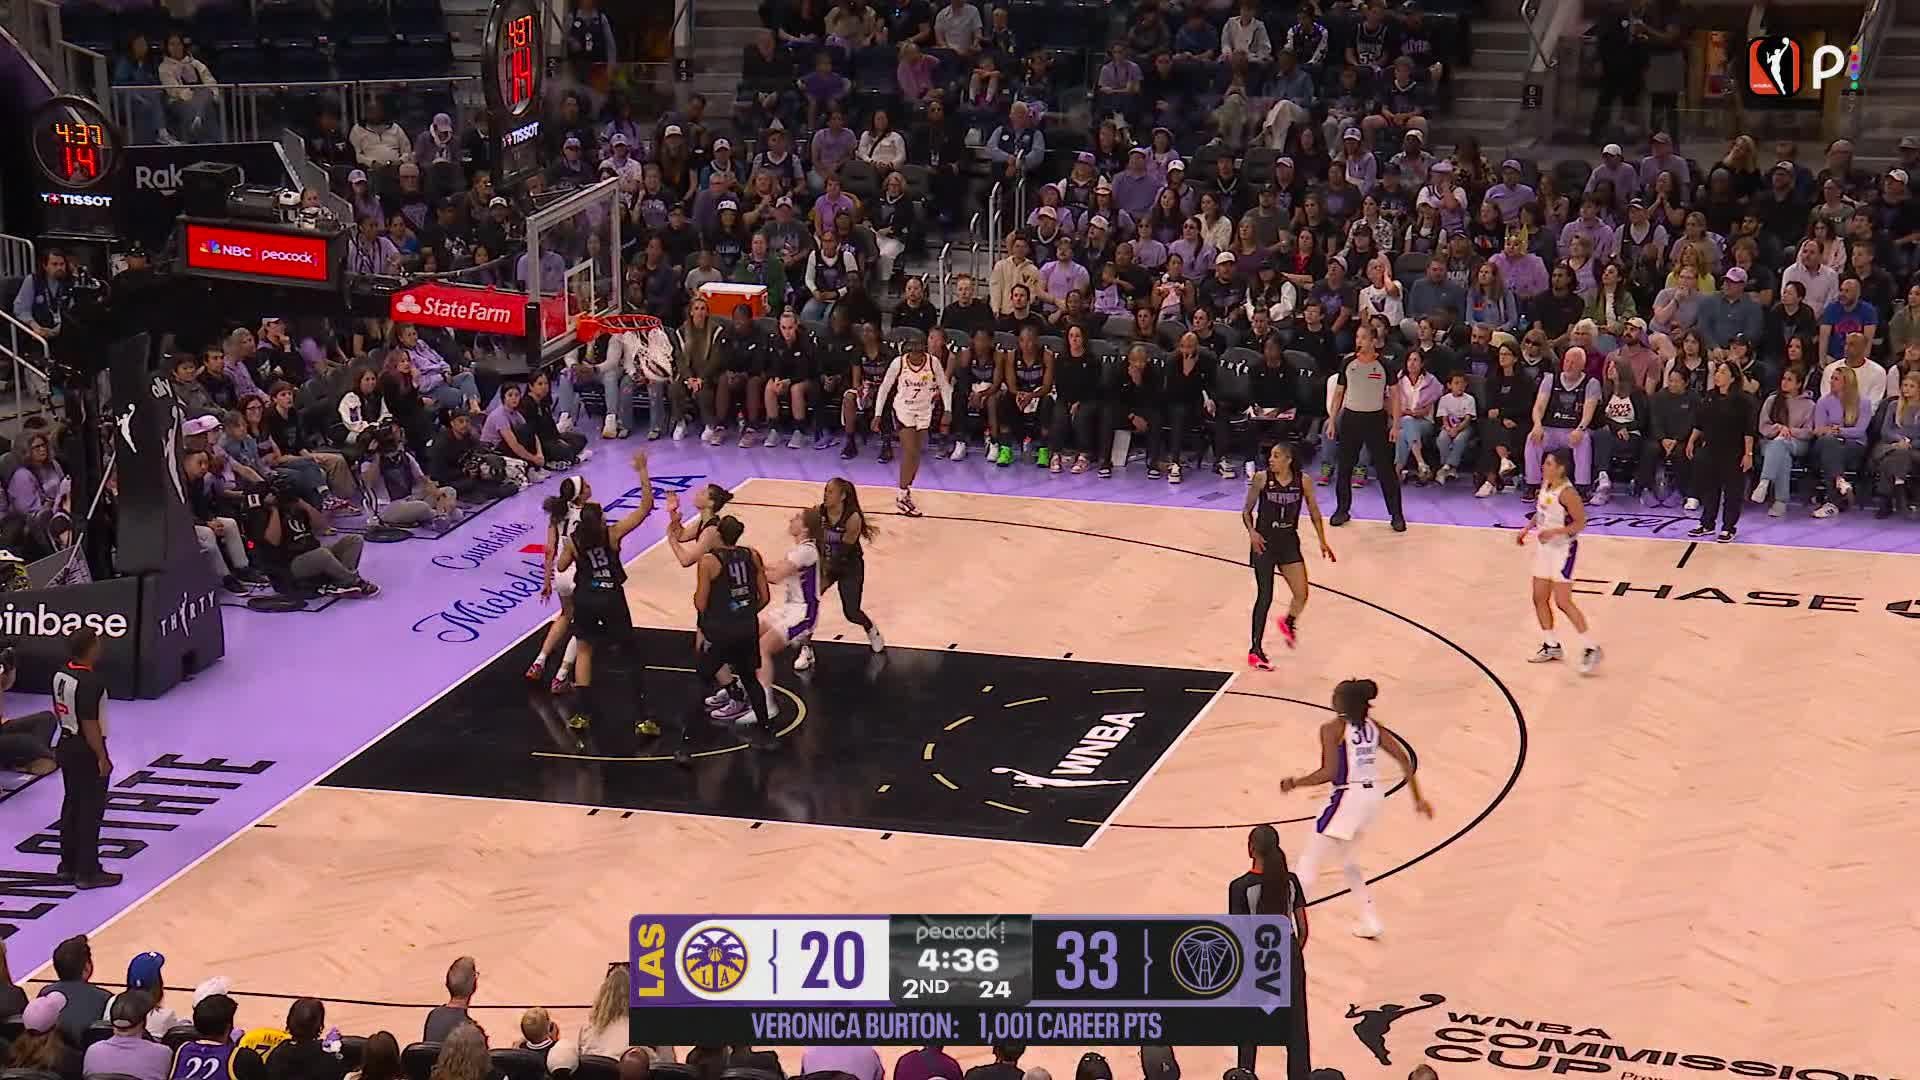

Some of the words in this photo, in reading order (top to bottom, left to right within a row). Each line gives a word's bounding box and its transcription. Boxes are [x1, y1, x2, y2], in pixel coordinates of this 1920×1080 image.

[512, 48, 533, 104] 14
[56, 123, 102, 145] 4:37
[512, 122, 539, 144] TISSOT
[65, 147, 96, 177] 14
[136, 164, 183, 189] Rak
[61, 194, 112, 207] TISSOT
[222, 245, 252, 258] NBC
[261, 250, 312, 264] peacock
[151, 376, 173, 398] ally
[913, 388, 921, 399] 7
[1280, 506, 1285, 519] 1
[432, 524, 528, 569] Courtside
[587, 546, 609, 569] 13
[728, 560, 748, 585] 41
[1571, 578, 1864, 613] CHASE
[1051, 712, 1146, 774] WNBA
[1352, 722, 1374, 744] 30
[1447, 1012, 1612, 1040] WNBA
[1424, 1044, 1612, 1076] CUP
